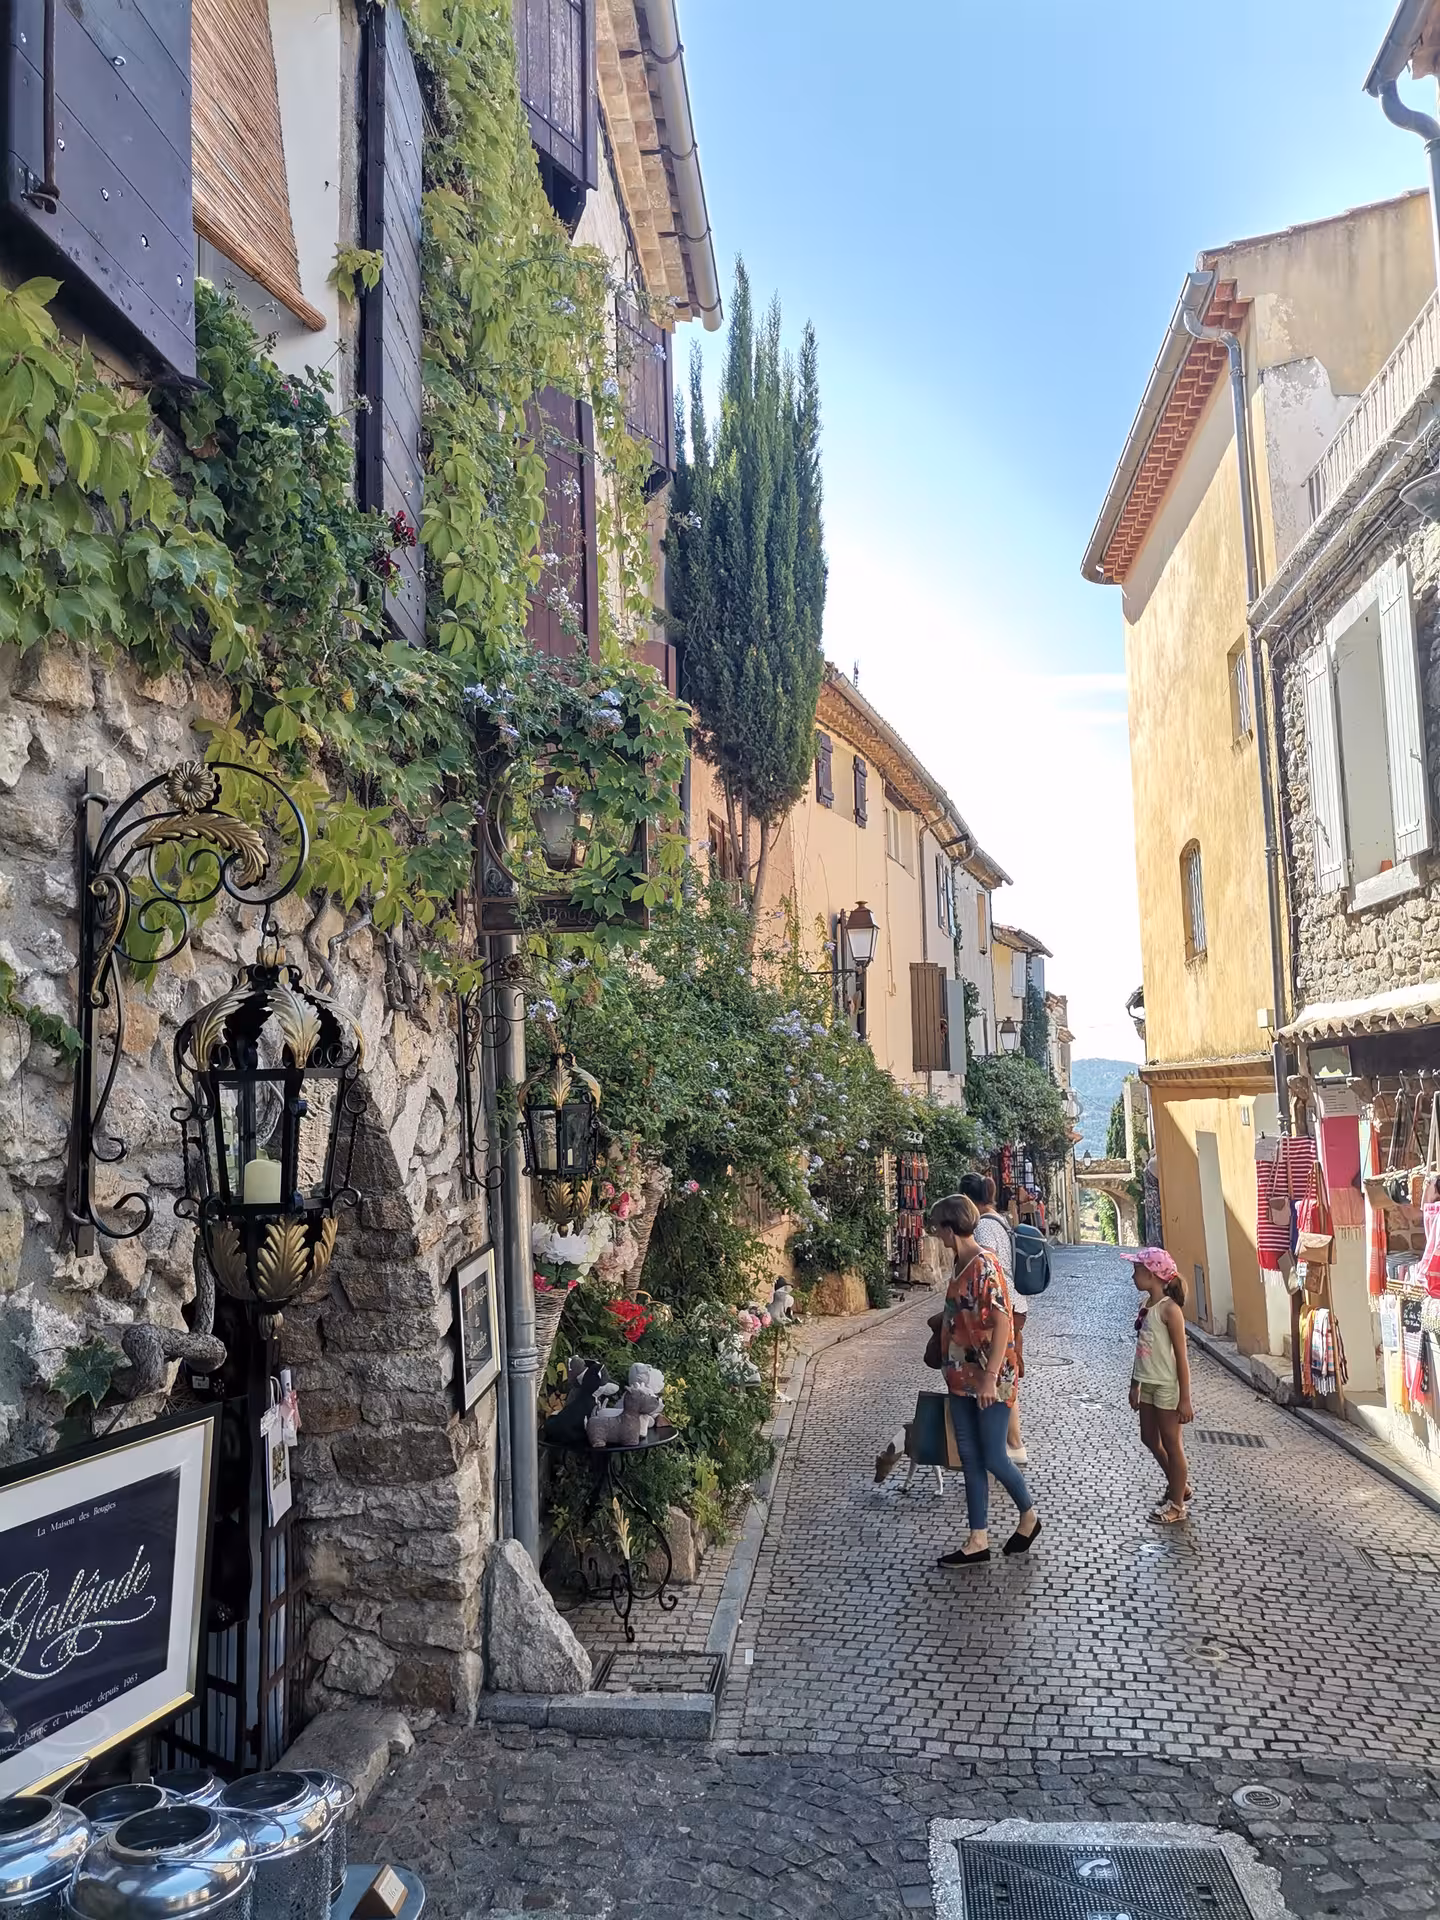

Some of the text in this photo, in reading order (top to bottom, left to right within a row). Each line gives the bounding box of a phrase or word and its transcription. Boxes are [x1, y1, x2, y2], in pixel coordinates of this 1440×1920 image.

[37, 1501, 117, 1537] La Maison des Bougies
[0, 1544, 157, 1680] Galéjade
[17, 1723, 49, 1746] Charme
[52, 1716, 60, 1727] et
[65, 1699, 93, 1719] Volupté
[97, 1684, 120, 1703] depuis
[123, 1672, 138, 1688] 1963
